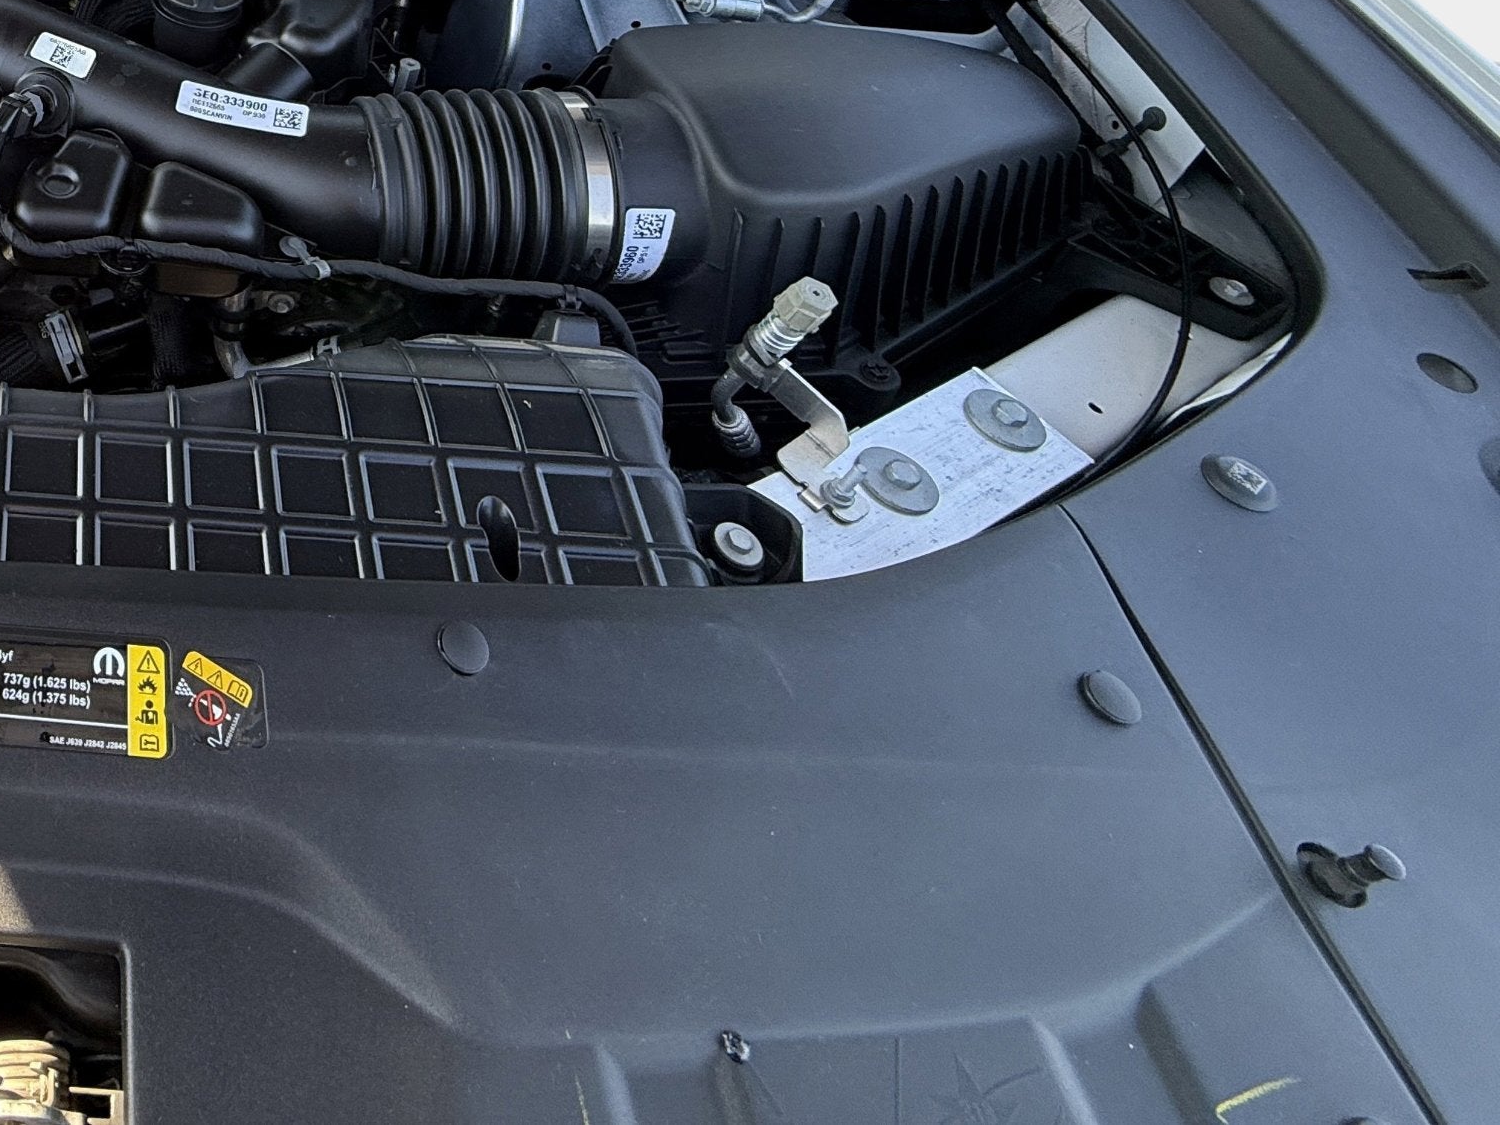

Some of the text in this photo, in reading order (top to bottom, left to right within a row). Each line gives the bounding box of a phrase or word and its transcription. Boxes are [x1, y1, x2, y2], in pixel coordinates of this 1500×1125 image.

[3, 672, 31, 688] 737g
[32, 674, 67, 689] (1.625
[69, 679, 91, 694] lbs)
[92, 677, 126, 687] MOPAR
[2, 688, 30, 704] 624g
[32, 690, 67, 705] (1.375
[69, 694, 91, 710] lbs)
[49, 735, 65, 745] SAE
